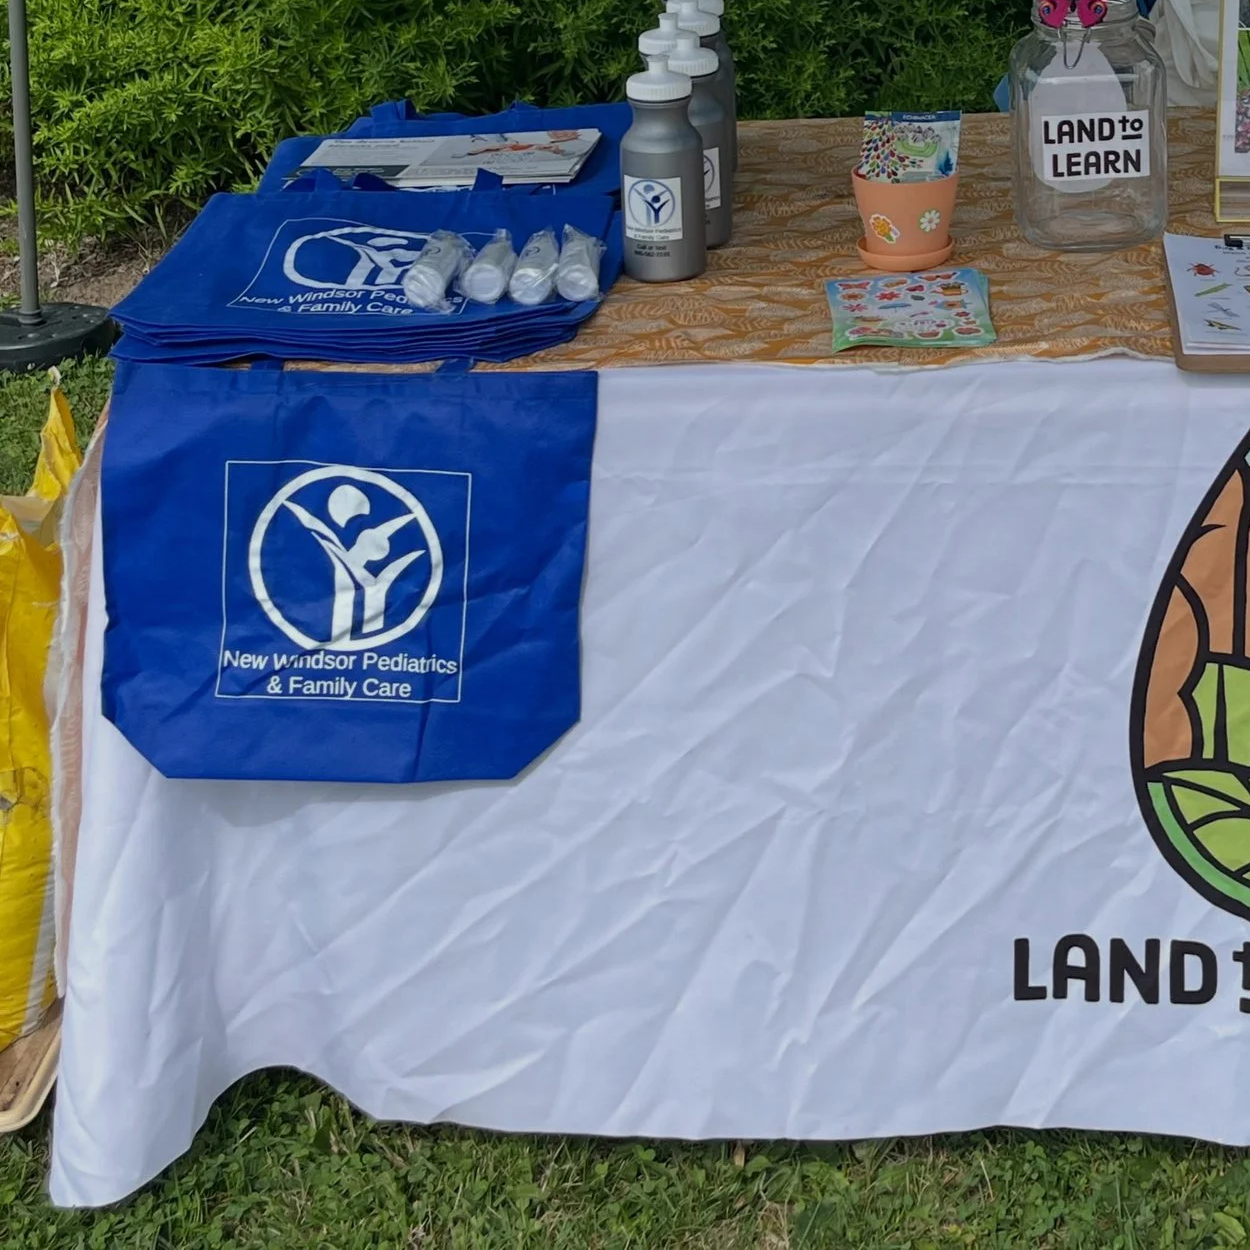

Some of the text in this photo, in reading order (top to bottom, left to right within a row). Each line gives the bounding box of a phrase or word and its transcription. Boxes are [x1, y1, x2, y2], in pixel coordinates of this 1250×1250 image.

[1043, 115, 1144, 144] LAND to
[1052, 149, 1142, 178] LEARN
[240, 296, 284, 304] New
[289, 289, 366, 304] Windsor
[277, 302, 413, 315] & Family Care
[223, 650, 458, 674] New Windsor Pediatrics
[266, 676, 412, 699] & Family Care
[1013, 933, 1218, 1005] LAND
